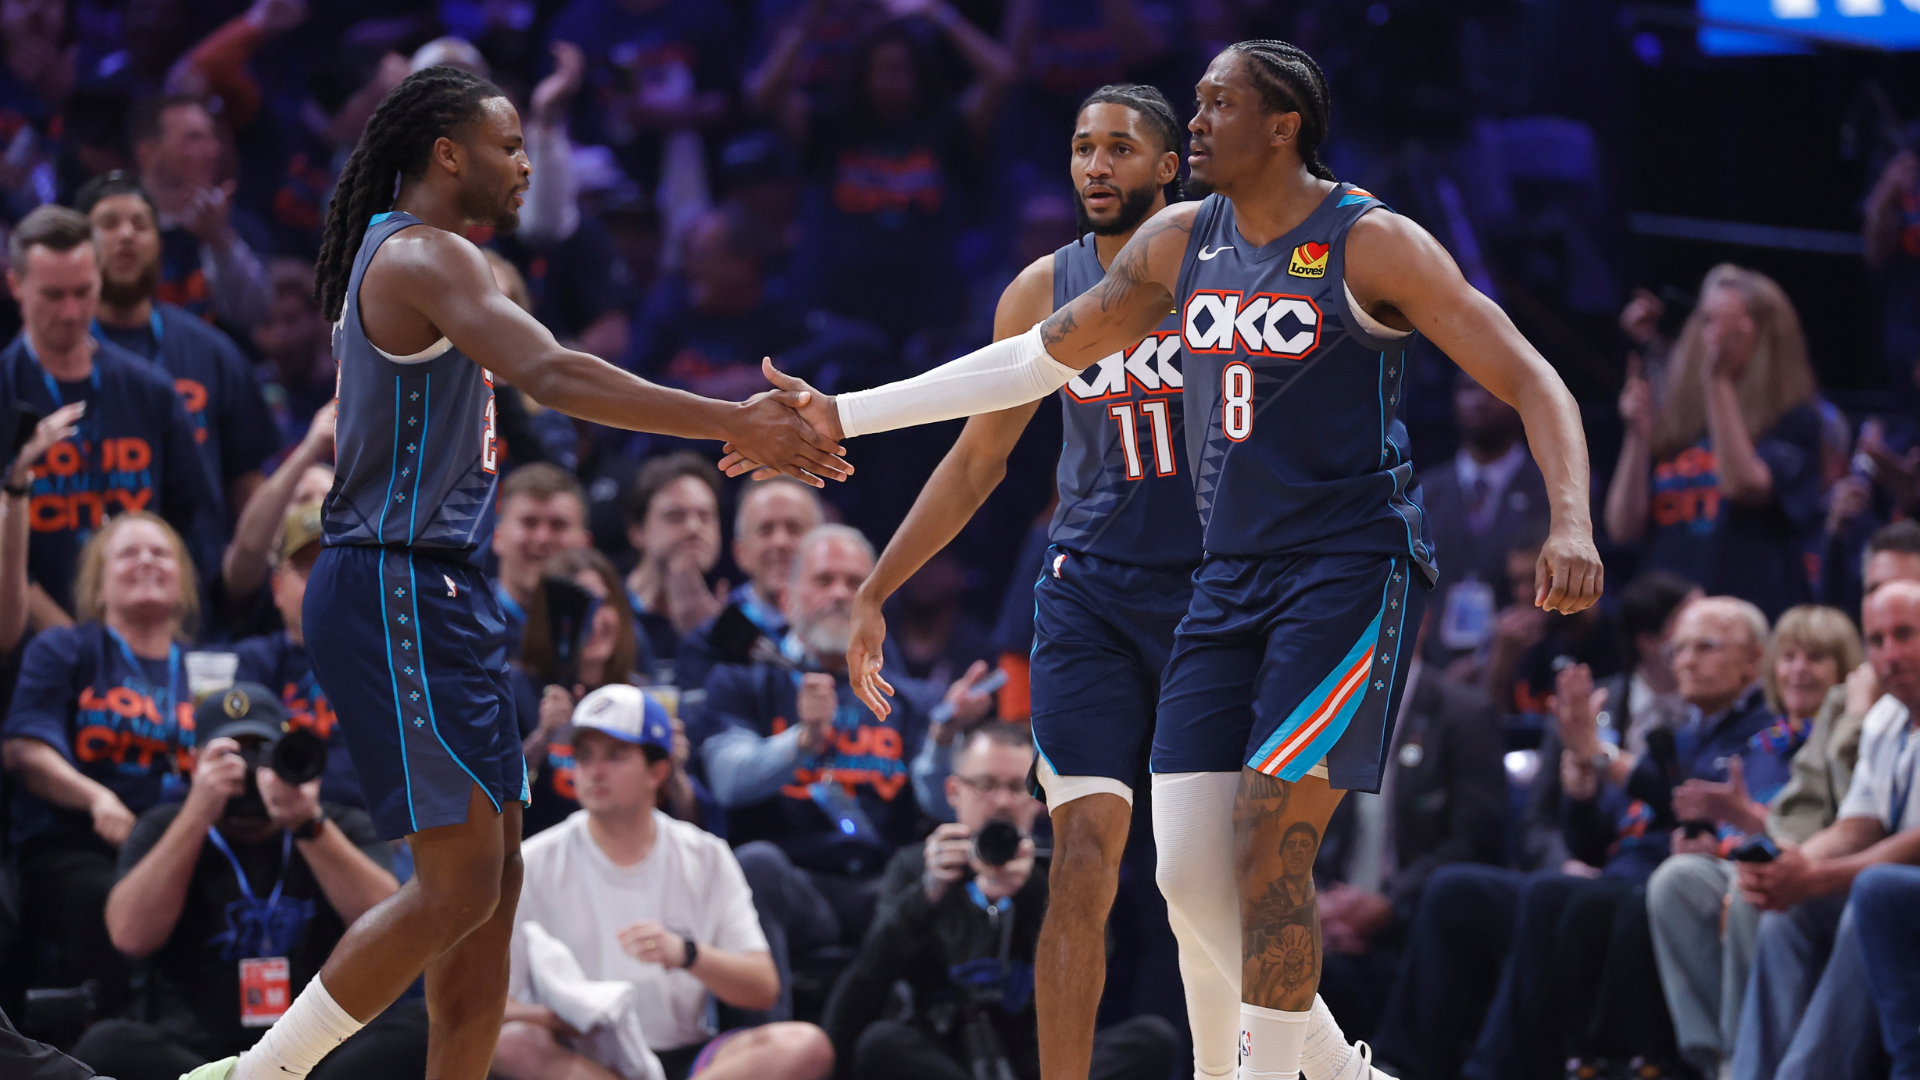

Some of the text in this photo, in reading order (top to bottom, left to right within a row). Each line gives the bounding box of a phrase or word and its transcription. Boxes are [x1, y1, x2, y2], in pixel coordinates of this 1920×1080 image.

[1290, 263, 1324, 276] Love's
[1182, 289, 1323, 360] OKC
[1107, 398, 1177, 480] 11
[1222, 361, 1254, 442] 8
